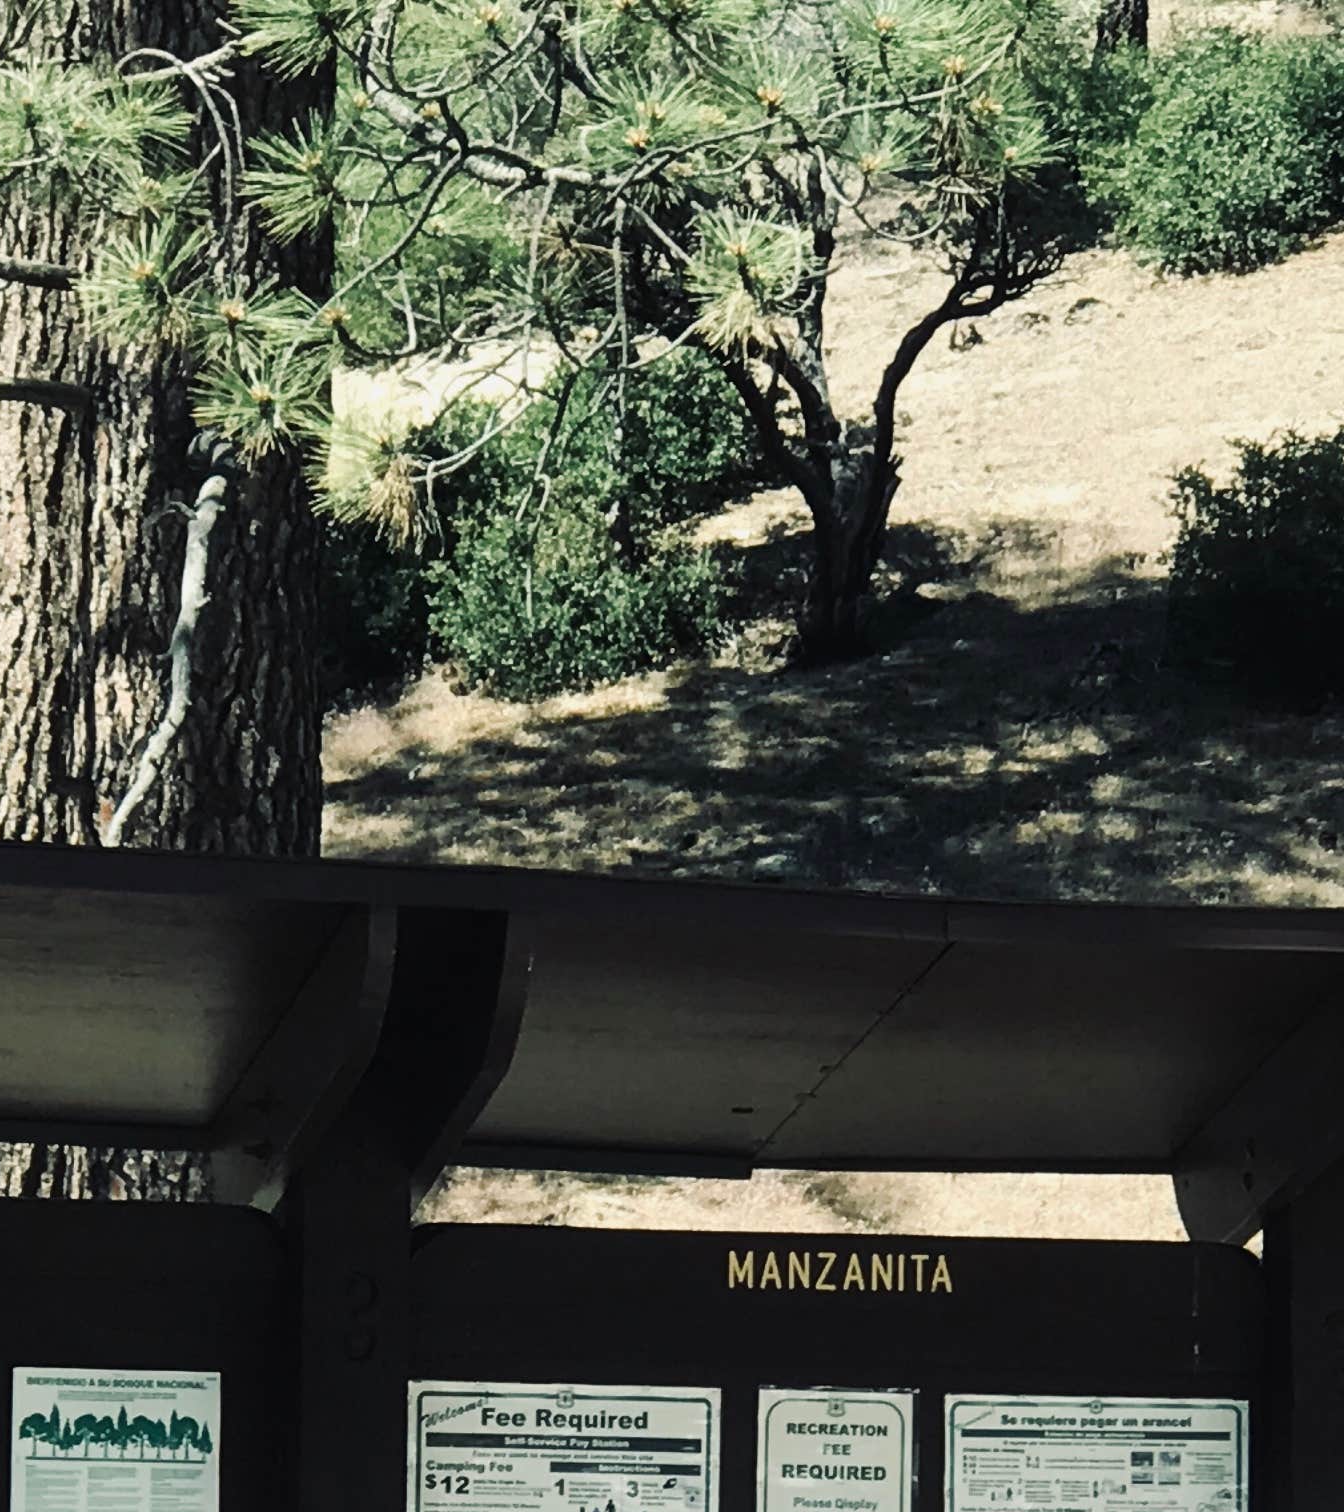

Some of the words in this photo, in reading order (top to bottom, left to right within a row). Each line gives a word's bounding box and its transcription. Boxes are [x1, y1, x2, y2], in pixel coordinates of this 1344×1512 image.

[728, 1251, 952, 1293] MANZANITA
[481, 1408, 526, 1426] Fee
[536, 1408, 648, 1432] Required
[1001, 1415, 1017, 1427] Se
[1021, 1415, 1077, 1428] requiere
[1081, 1416, 1119, 1428] pagar
[1122, 1418, 1138, 1427] un
[787, 1423, 888, 1436] RECREATION
[426, 1460, 485, 1473] Camping
[490, 1462, 513, 1472] Fee
[782, 1464, 886, 1481] REQUIRED
[555, 1479, 565, 1495] 1
[627, 1481, 638, 1497] 3
[794, 1497, 831, 1508] Please
[835, 1498, 878, 1511] Display
